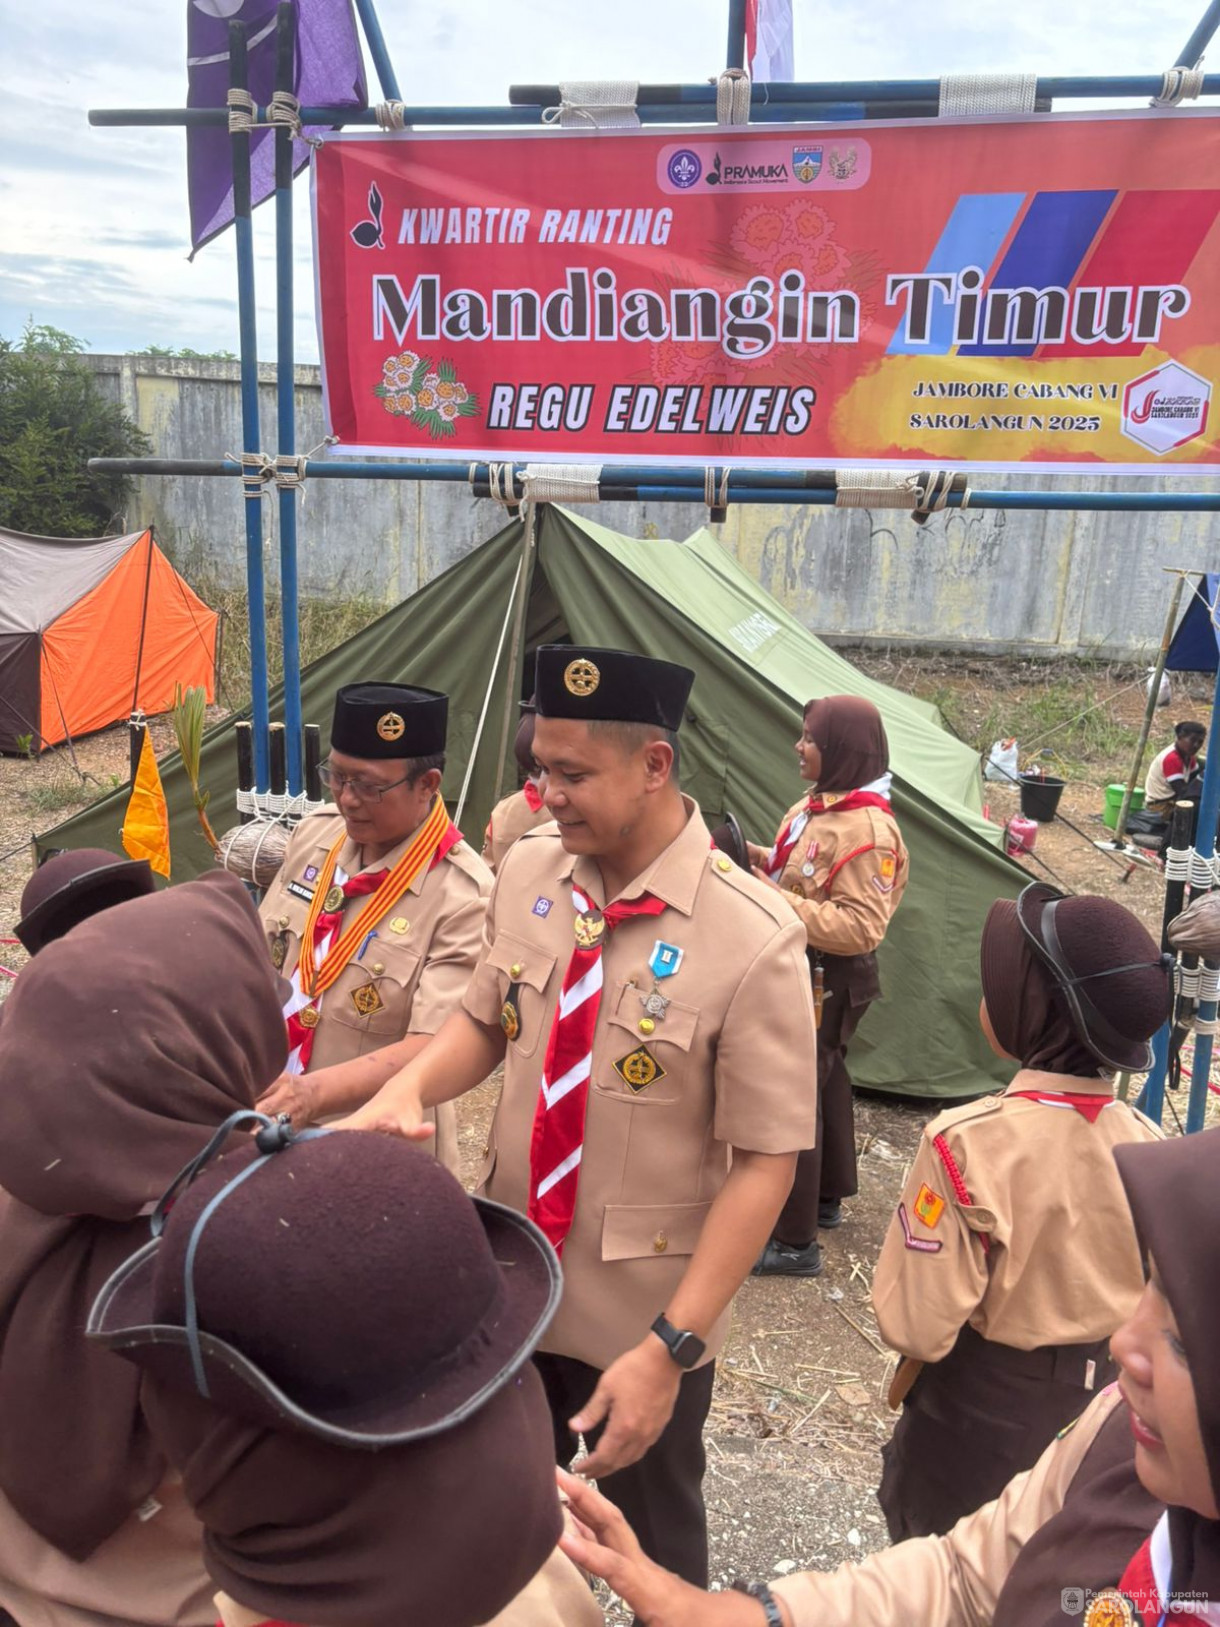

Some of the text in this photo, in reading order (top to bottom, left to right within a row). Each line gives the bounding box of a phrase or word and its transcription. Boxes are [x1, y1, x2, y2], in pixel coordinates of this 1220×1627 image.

[724, 164, 789, 179] PRAMUKA
[398, 207, 674, 246] KWARTIR RANTING
[372, 265, 1191, 360] Mandiangin Timur
[913, 382, 1119, 400] JAMBORE CABANG VI
[486, 383, 818, 435] REGU EDELWEIS
[910, 414, 1101, 432] SAROLANGUN 2025
